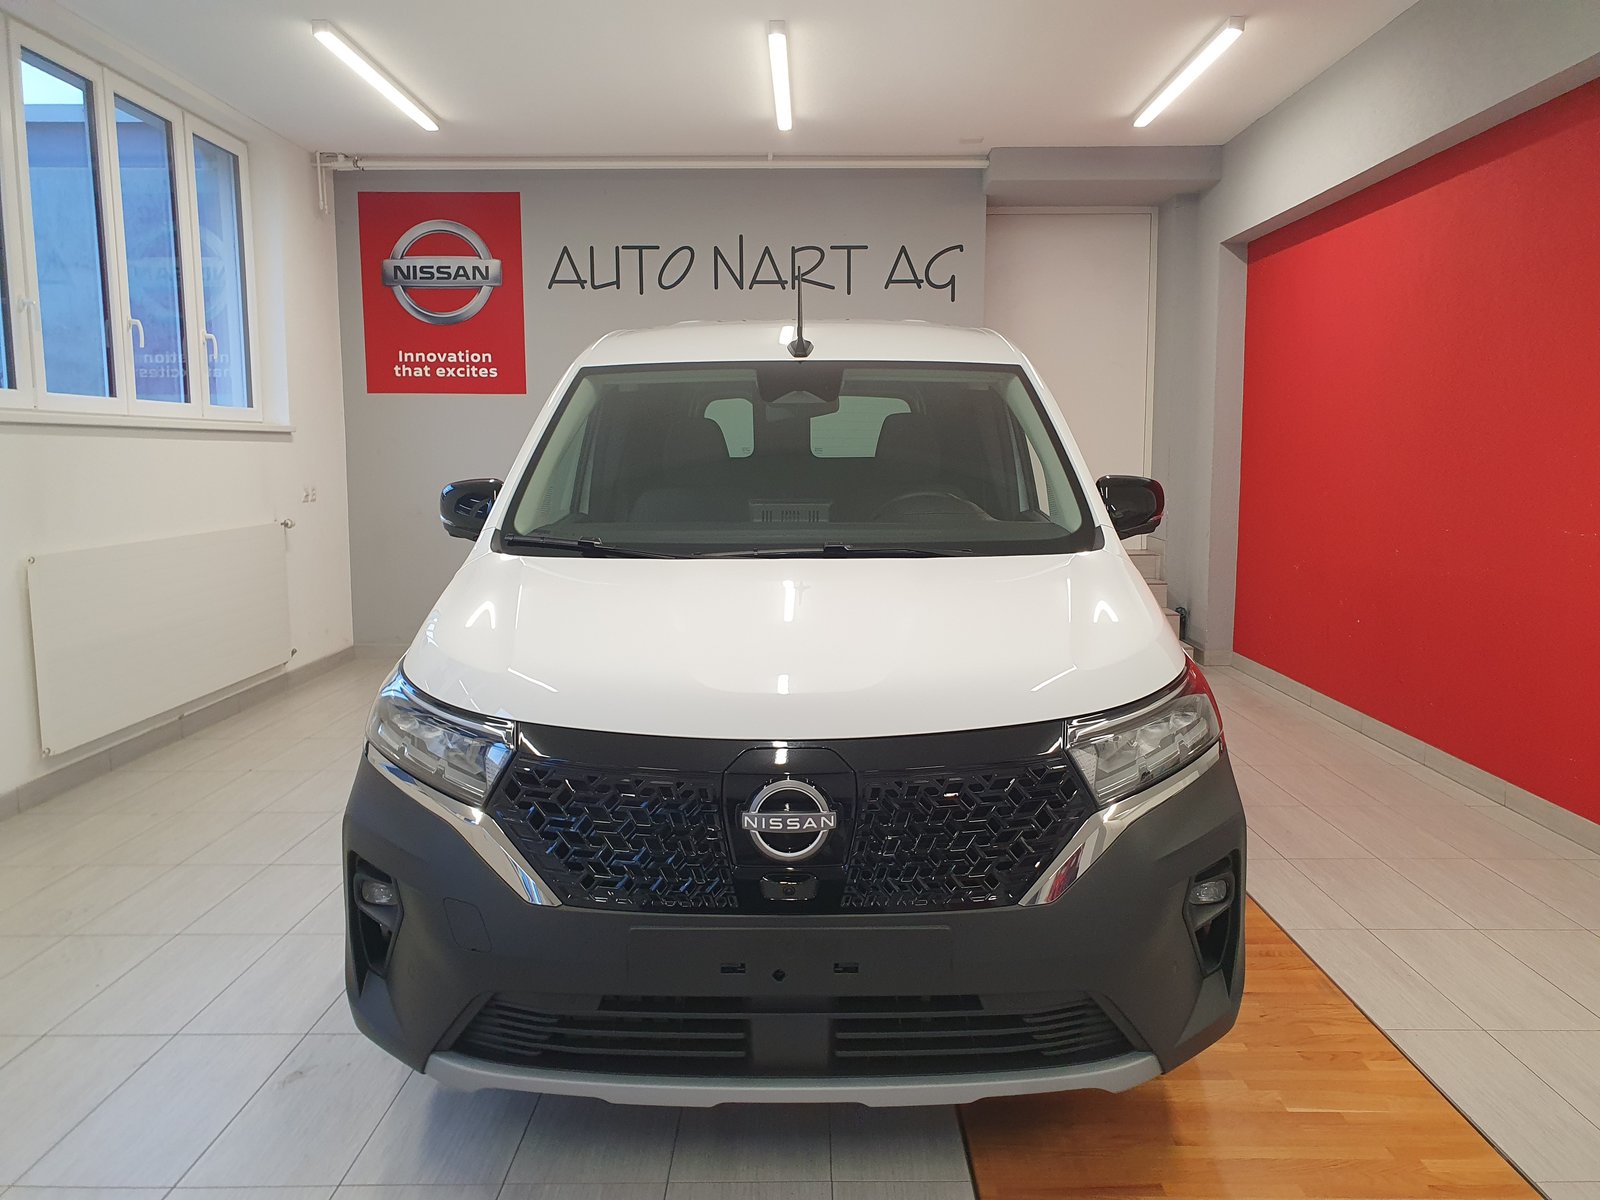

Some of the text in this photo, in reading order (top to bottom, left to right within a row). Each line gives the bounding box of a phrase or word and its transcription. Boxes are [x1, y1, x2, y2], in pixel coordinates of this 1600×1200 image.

[393, 265, 489, 280] NISSAN
[547, 234, 964, 303] AUTO NART AG
[398, 350, 492, 363] Innovation
[393, 364, 498, 378] that excites
[744, 815, 834, 830] NISSAN
